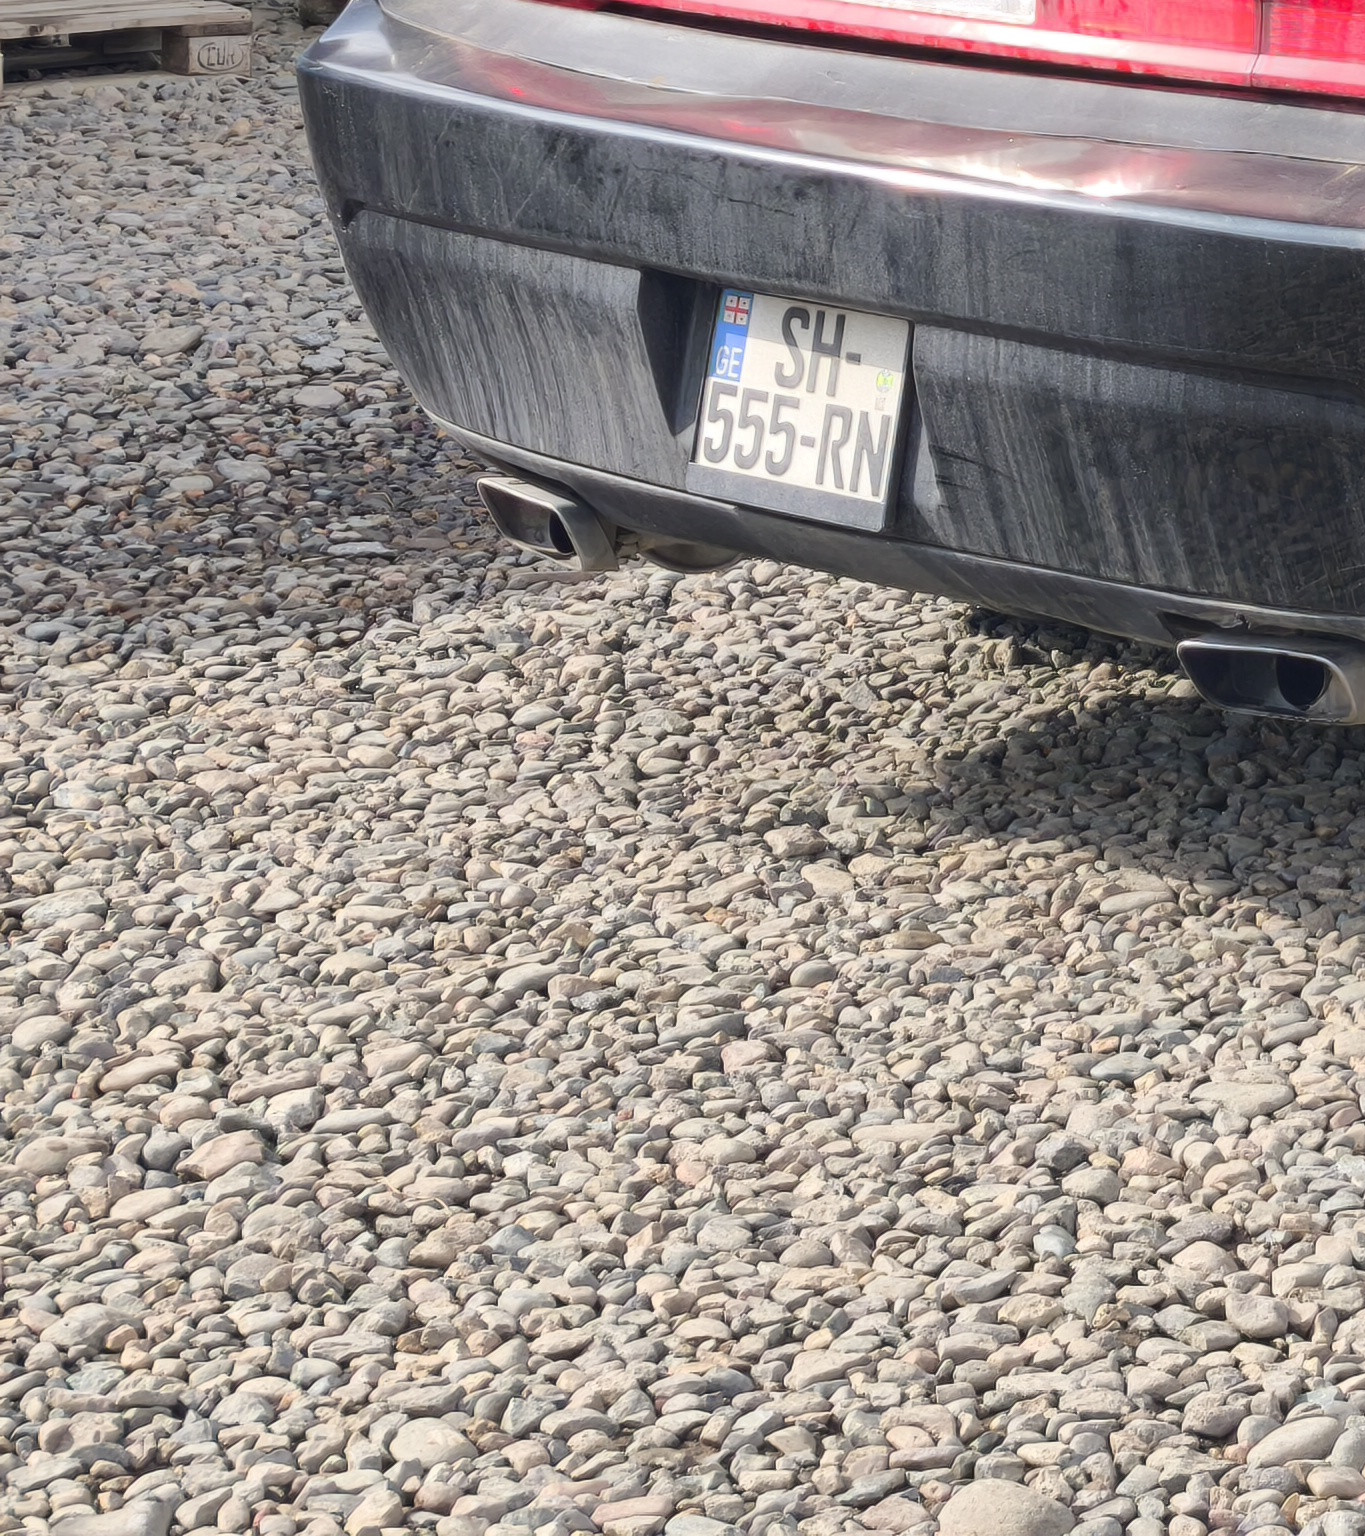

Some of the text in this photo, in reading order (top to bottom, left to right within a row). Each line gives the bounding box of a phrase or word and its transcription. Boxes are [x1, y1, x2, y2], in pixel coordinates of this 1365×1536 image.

[715, 345, 743, 379] GE
[774, 306, 861, 397] SH-
[703, 382, 892, 497] 555-RN
